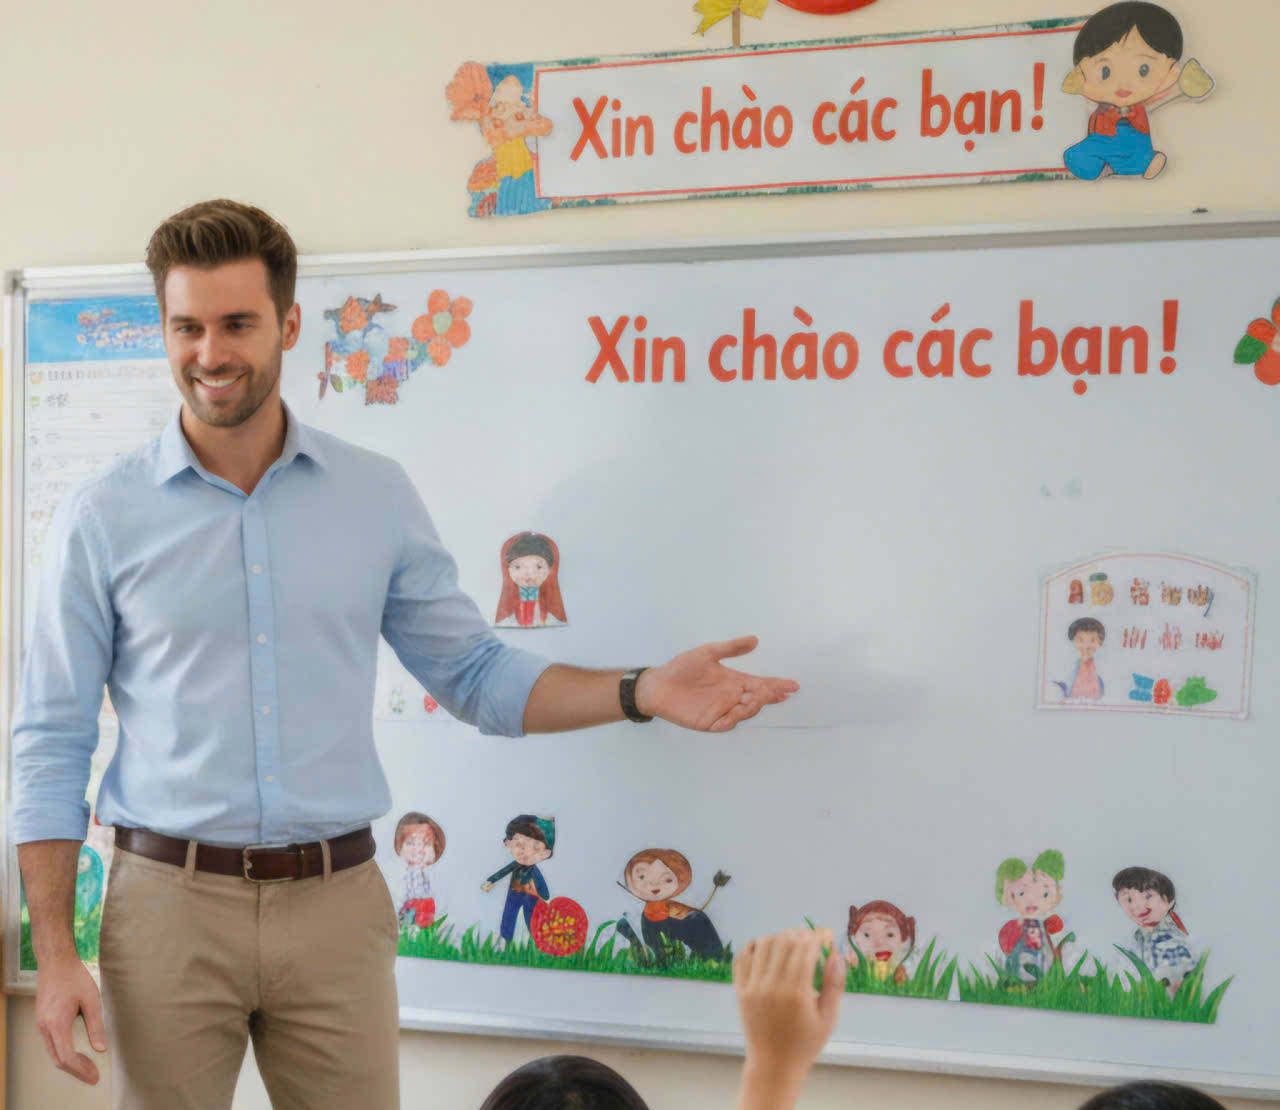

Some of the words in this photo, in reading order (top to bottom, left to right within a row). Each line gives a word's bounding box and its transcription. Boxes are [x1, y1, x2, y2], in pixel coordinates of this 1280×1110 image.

[570, 95, 654, 161] Xin
[673, 84, 793, 154] chào
[811, 76, 898, 145] các
[919, 62, 1045, 152] bạn!
[585, 315, 686, 383] Xin
[708, 306, 859, 382] chào
[883, 303, 993, 378] các
[1017, 299, 1179, 395] bạn!
